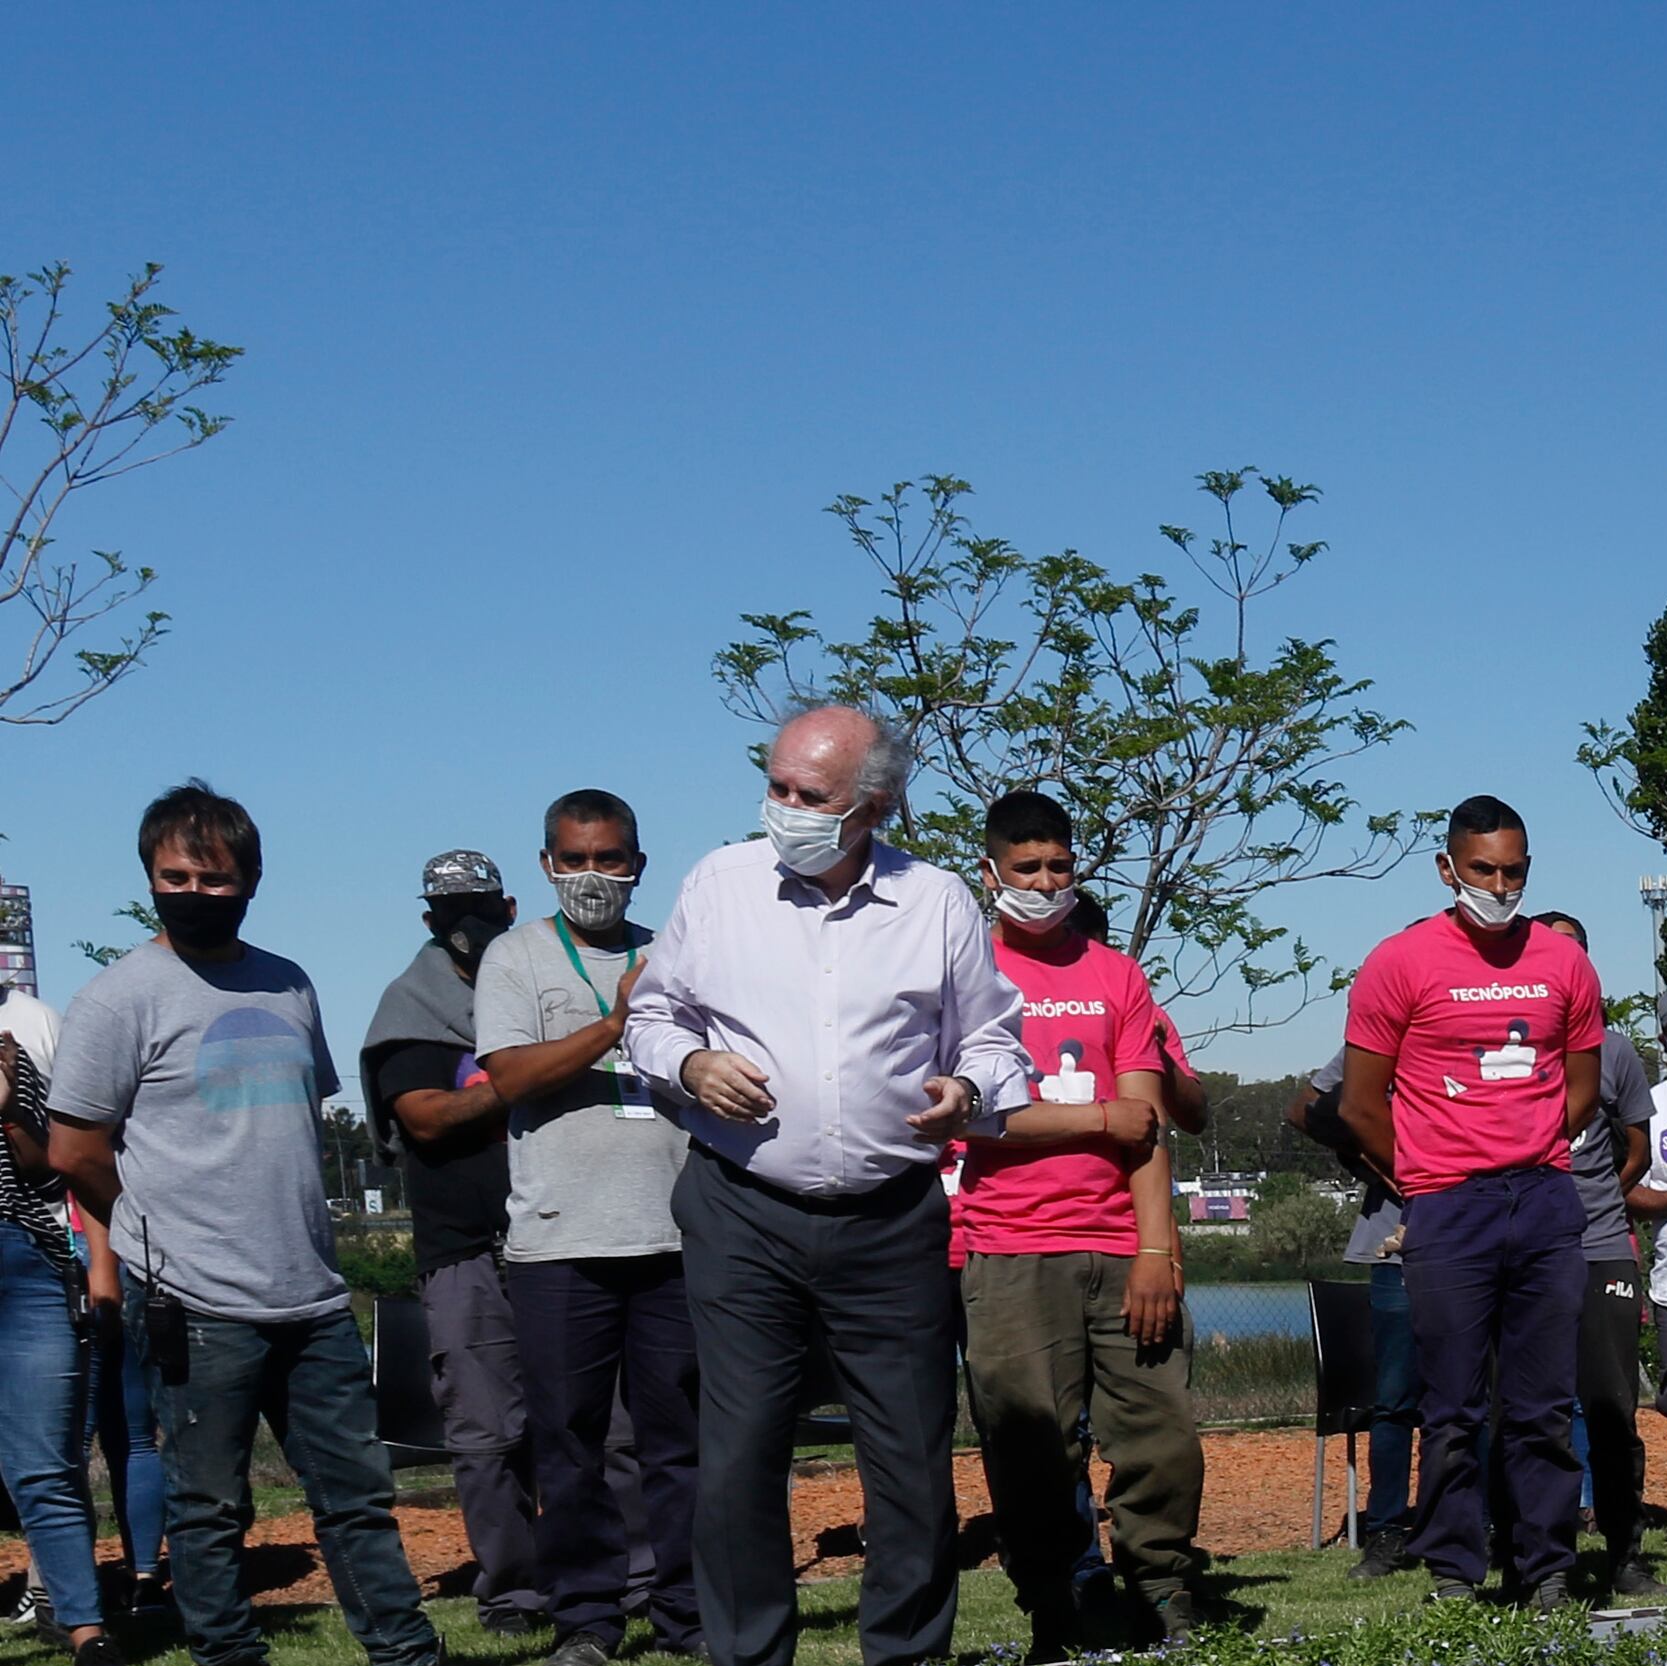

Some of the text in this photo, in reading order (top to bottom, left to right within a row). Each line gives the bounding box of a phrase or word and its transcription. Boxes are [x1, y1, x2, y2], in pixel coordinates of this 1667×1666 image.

[1448, 982, 1549, 1002] TECNÓPOLIS
[1022, 998, 1106, 1018] CNÓPOLIS
[1605, 1280, 1635, 1299] FILA
